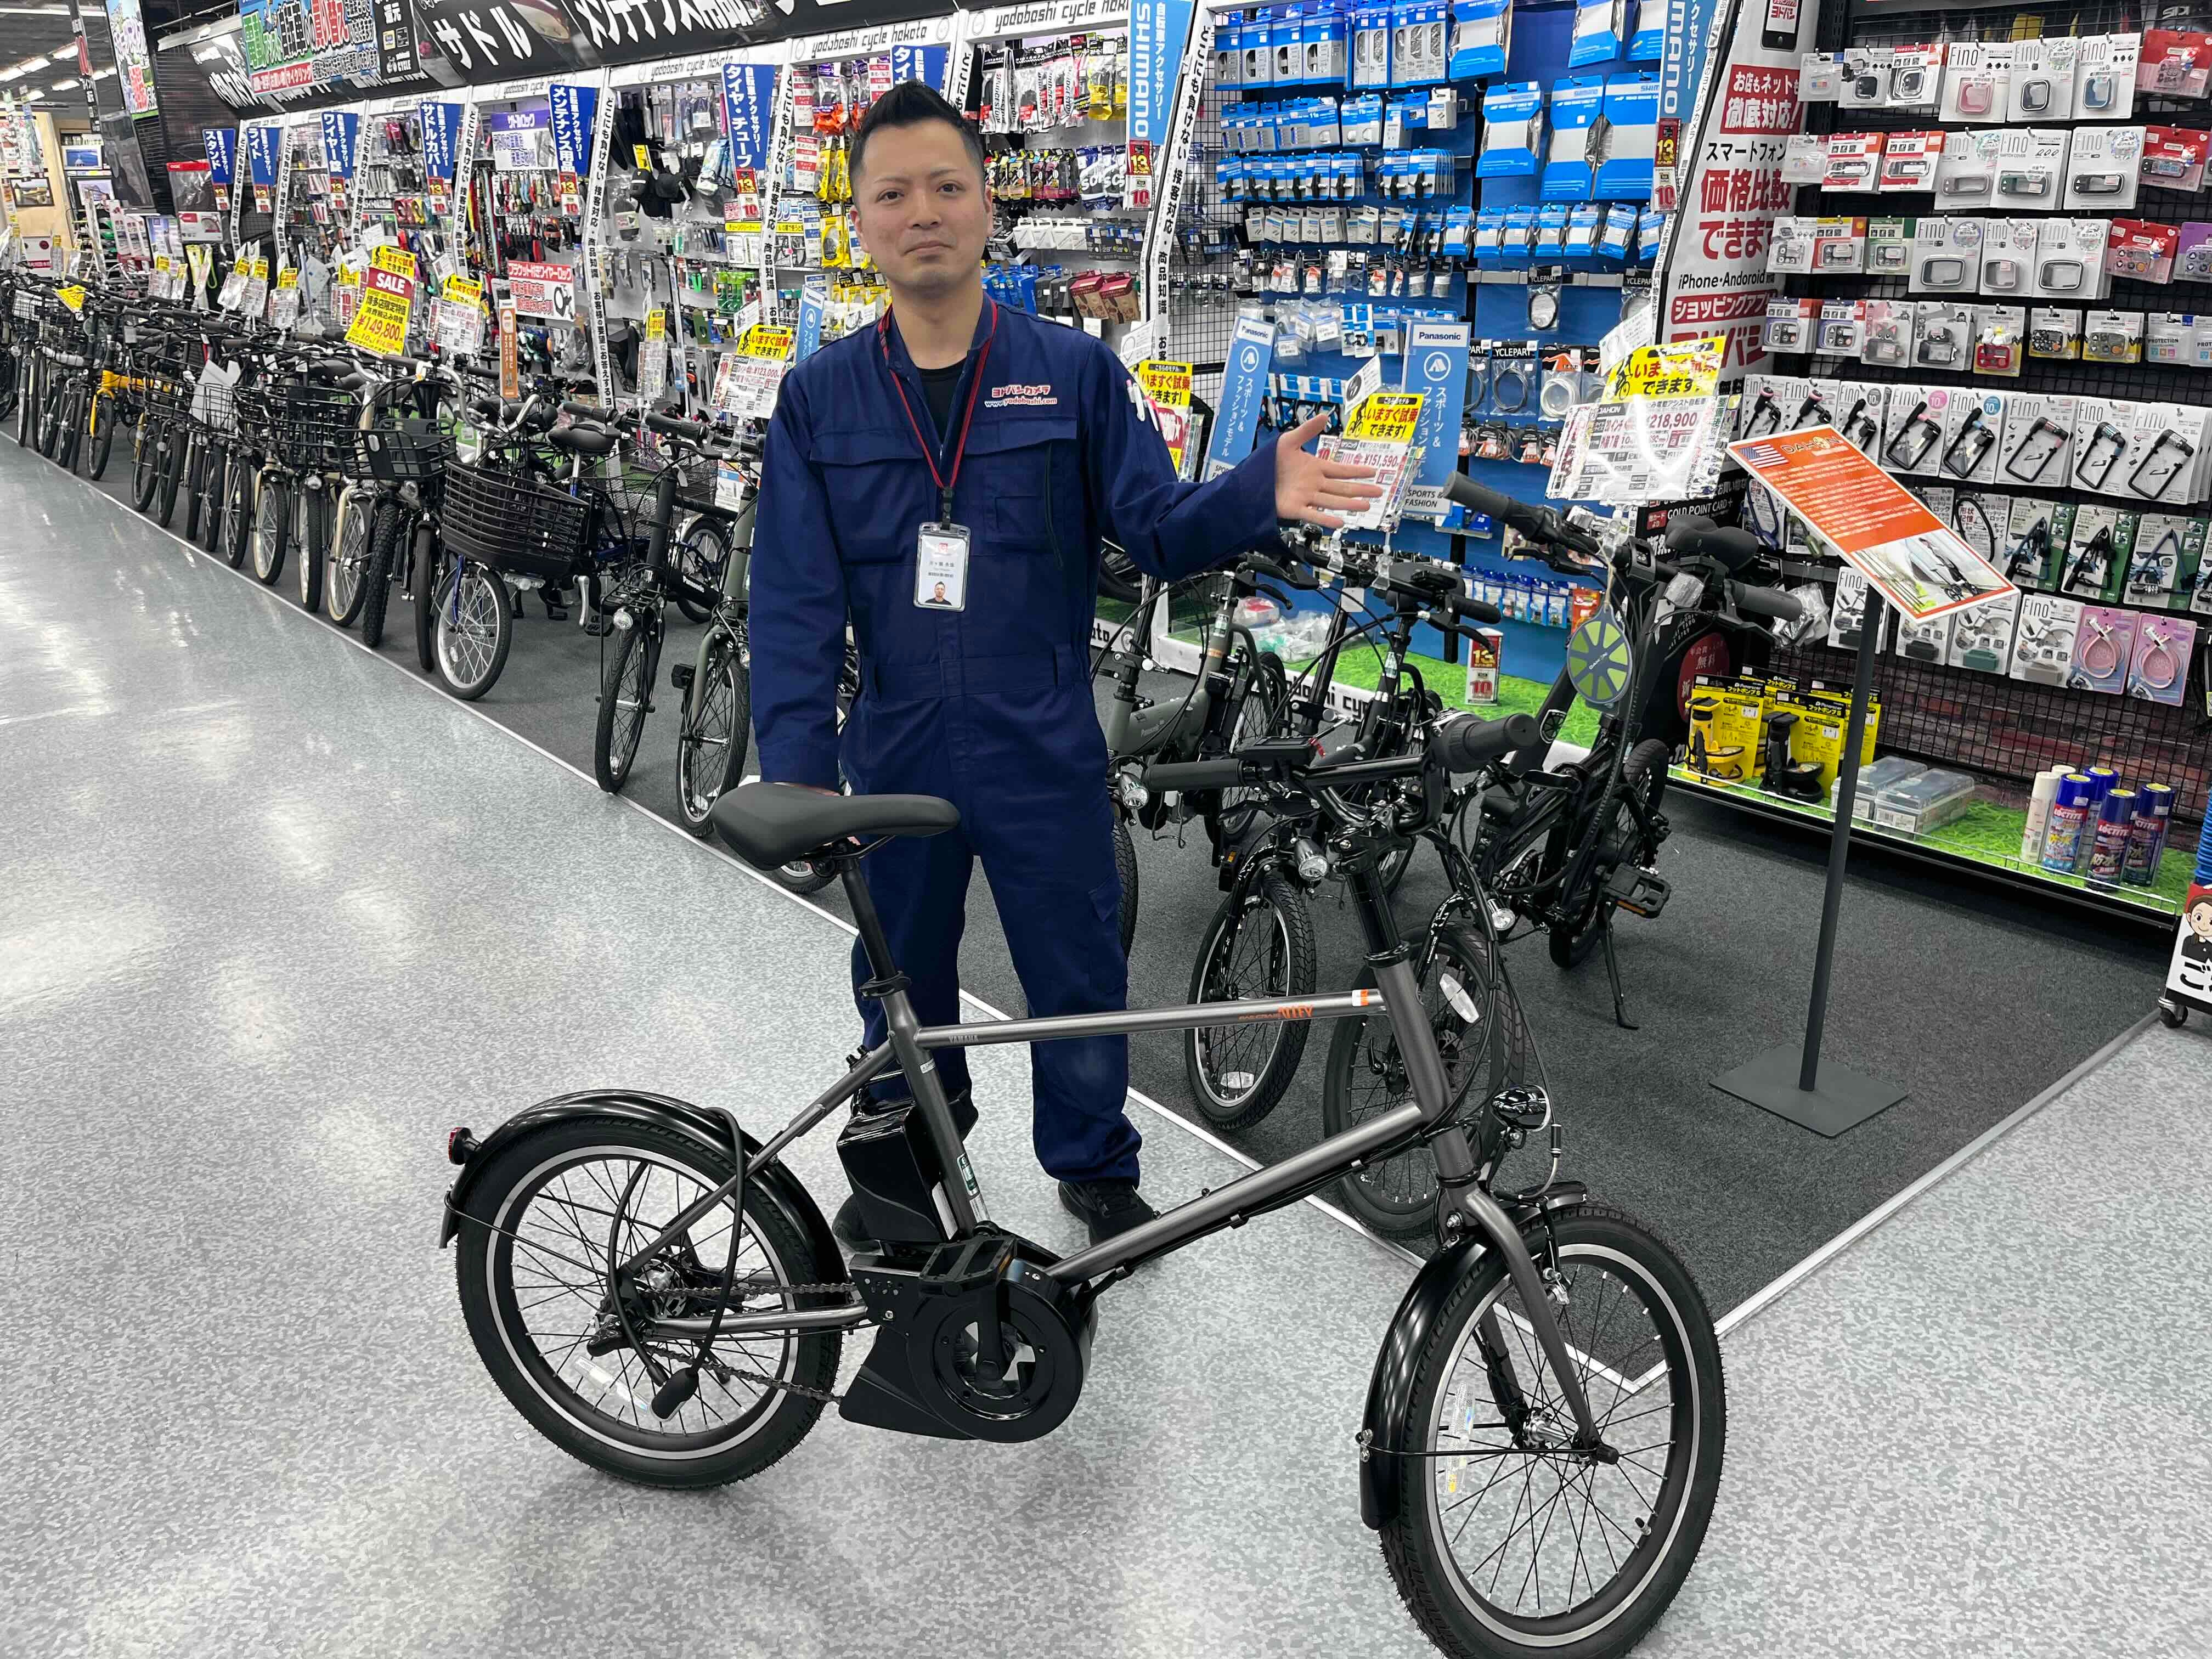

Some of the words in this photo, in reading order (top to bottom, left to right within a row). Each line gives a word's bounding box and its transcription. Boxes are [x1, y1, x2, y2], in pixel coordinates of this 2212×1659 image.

[995, 6, 1057, 34] yodobashi
[1062, 0, 1096, 24] cycle
[432, 5, 532, 70] サドル
[861, 26, 887, 52] cycle
[1687, 0, 1700, 89] クセサリー
[1950, 46, 1979, 66] Fino
[2080, 40, 2107, 61] Fino
[1135, 2, 1151, 138] SHIMANO
[1154, 2, 1166, 120] 自転車アクセサリー
[1177, 25, 1211, 160] どこにも負けない
[725, 66, 752, 168] タイヤ・チューブ
[1724, 97, 1799, 129] 徹底対応!
[552, 87, 575, 173] メンテナンス用品
[774, 74, 793, 174] どこにも負けない
[248, 128, 262, 160] ライト
[324, 114, 342, 173] ワイヤー錠
[421, 104, 441, 176] サドルカバー
[2000, 135, 2028, 153] Fino
[205, 131, 221, 170] スタンド
[1706, 141, 1786, 162] スマートフォン
[1700, 168, 1792, 214] 価格比較
[1699, 218, 1775, 261] できま
[1918, 222, 1946, 239] Fino
[1986, 222, 2008, 240] Fino
[376, 273, 405, 295] SALE
[751, 334, 789, 347] いますぐ試乗
[1242, 325, 1269, 339] Panasonic
[1418, 331, 1462, 341] Panasonic
[755, 346, 781, 358] できます!
[991, 385, 1051, 398] ヨドバシカメラ
[1141, 374, 1191, 390] いますぐ試乗
[1784, 381, 1809, 399] Fino
[984, 396, 1058, 408] www.yodobashi.com
[1241, 377, 1254, 417] スポーツ
[1892, 389, 1918, 407] Fino
[1951, 393, 1975, 411] Fino
[1221, 375, 1244, 457] ファッションモデル
[1365, 408, 1419, 424] いますぐ試乗
[1433, 387, 1447, 432] スポーツ
[2011, 398, 2040, 417] Fino
[2079, 402, 2103, 422] Fino
[1370, 424, 1407, 439] できます!
[1432, 436, 1441, 448] &
[1404, 498, 1438, 508] FASHION
[1407, 489, 1436, 499] SPORTS
[1667, 507, 1687, 520] GOLD
[1689, 503, 1712, 516] POINT
[1712, 500, 1727, 511] CARD
[1838, 572, 1863, 589] Fino
[2024, 599, 2049, 618] Fino
[2053, 809, 2083, 820] LOCTITE
[2098, 825, 2129, 837] LOCTITE
[949, 1035, 979, 1043] YAMAHA
